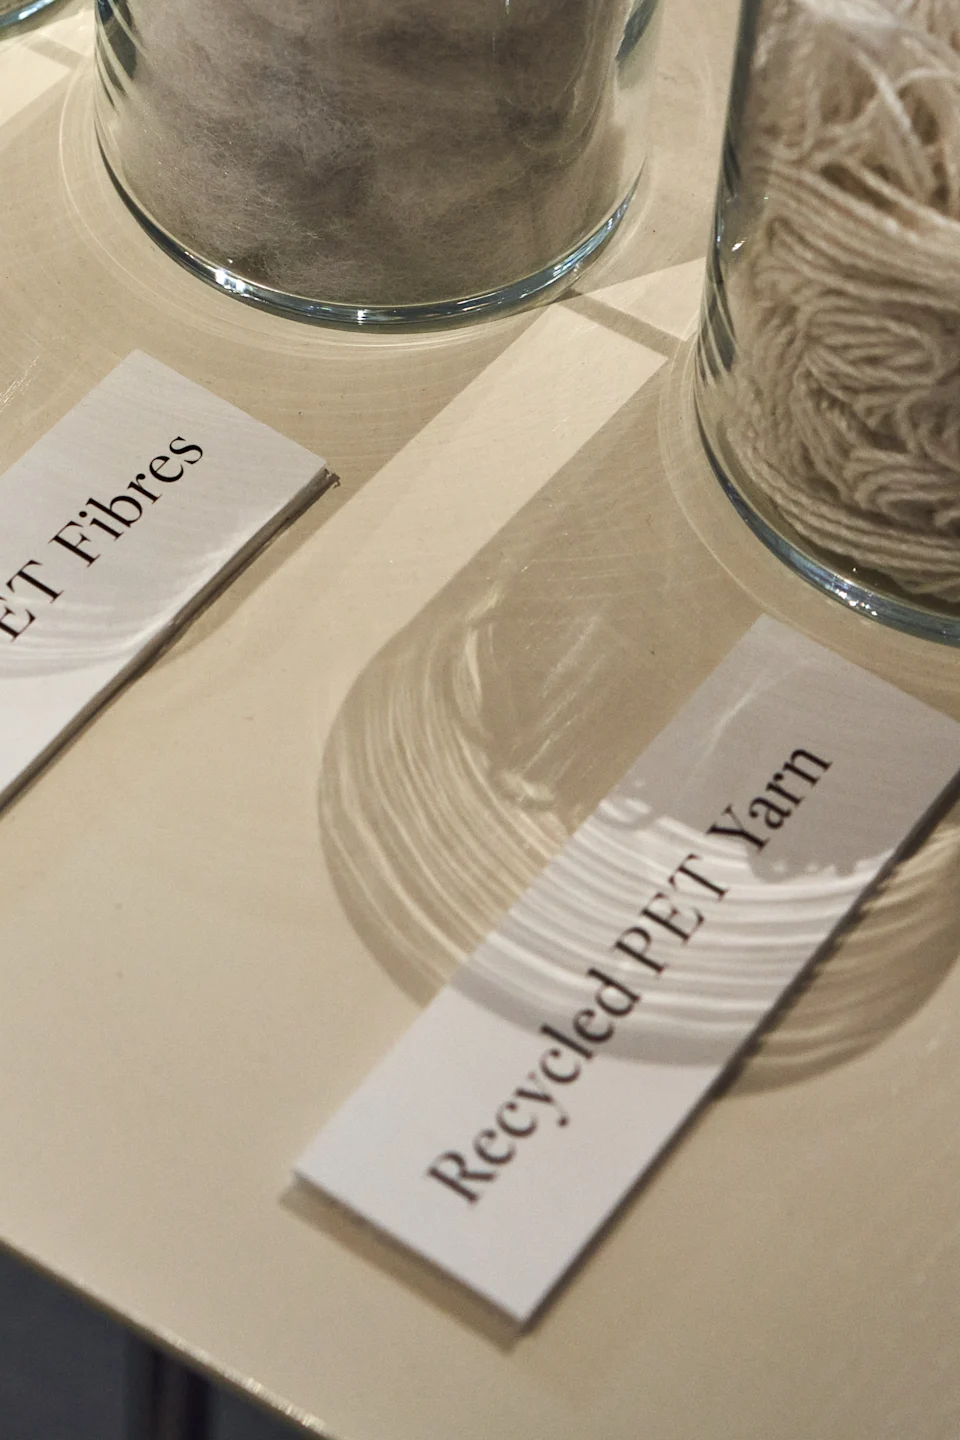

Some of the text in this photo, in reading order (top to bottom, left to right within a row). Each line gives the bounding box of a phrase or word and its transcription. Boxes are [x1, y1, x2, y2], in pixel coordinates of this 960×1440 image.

[48, 435, 204, 568] Fibres
[426, 747, 833, 1206] Recycled PET Yarn
